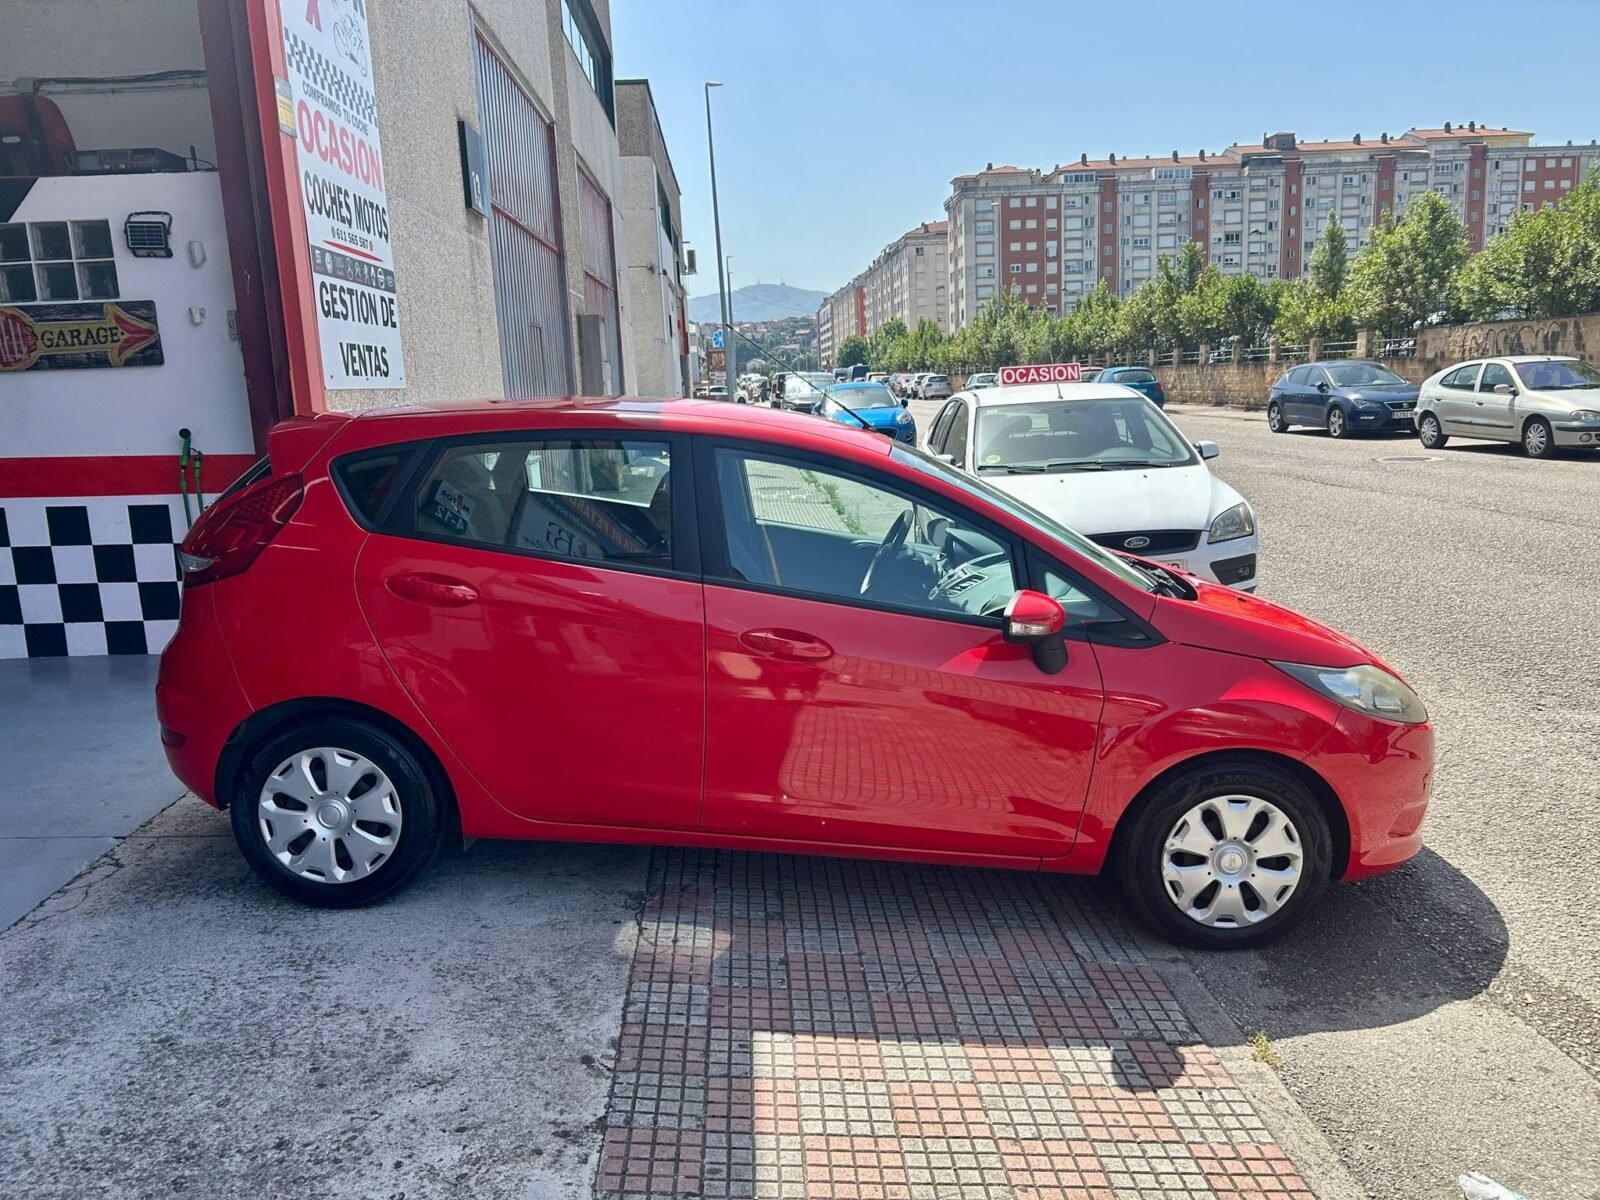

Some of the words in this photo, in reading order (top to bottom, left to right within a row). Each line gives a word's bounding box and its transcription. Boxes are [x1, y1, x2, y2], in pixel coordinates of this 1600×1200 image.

[302, 81, 342, 117] COMPRAMOS
[342, 108, 351, 124] TU
[351, 114, 369, 136] COCHE
[297, 99, 383, 192] OCASION
[304, 170, 352, 229] COCHES
[353, 193, 389, 243] MOTOS
[319, 280, 379, 326] GESTION
[380, 295, 397, 328] DE
[41, 326, 122, 348] GARAGE
[339, 342, 390, 378] VENTAS
[1003, 366, 1079, 383] OCASION
